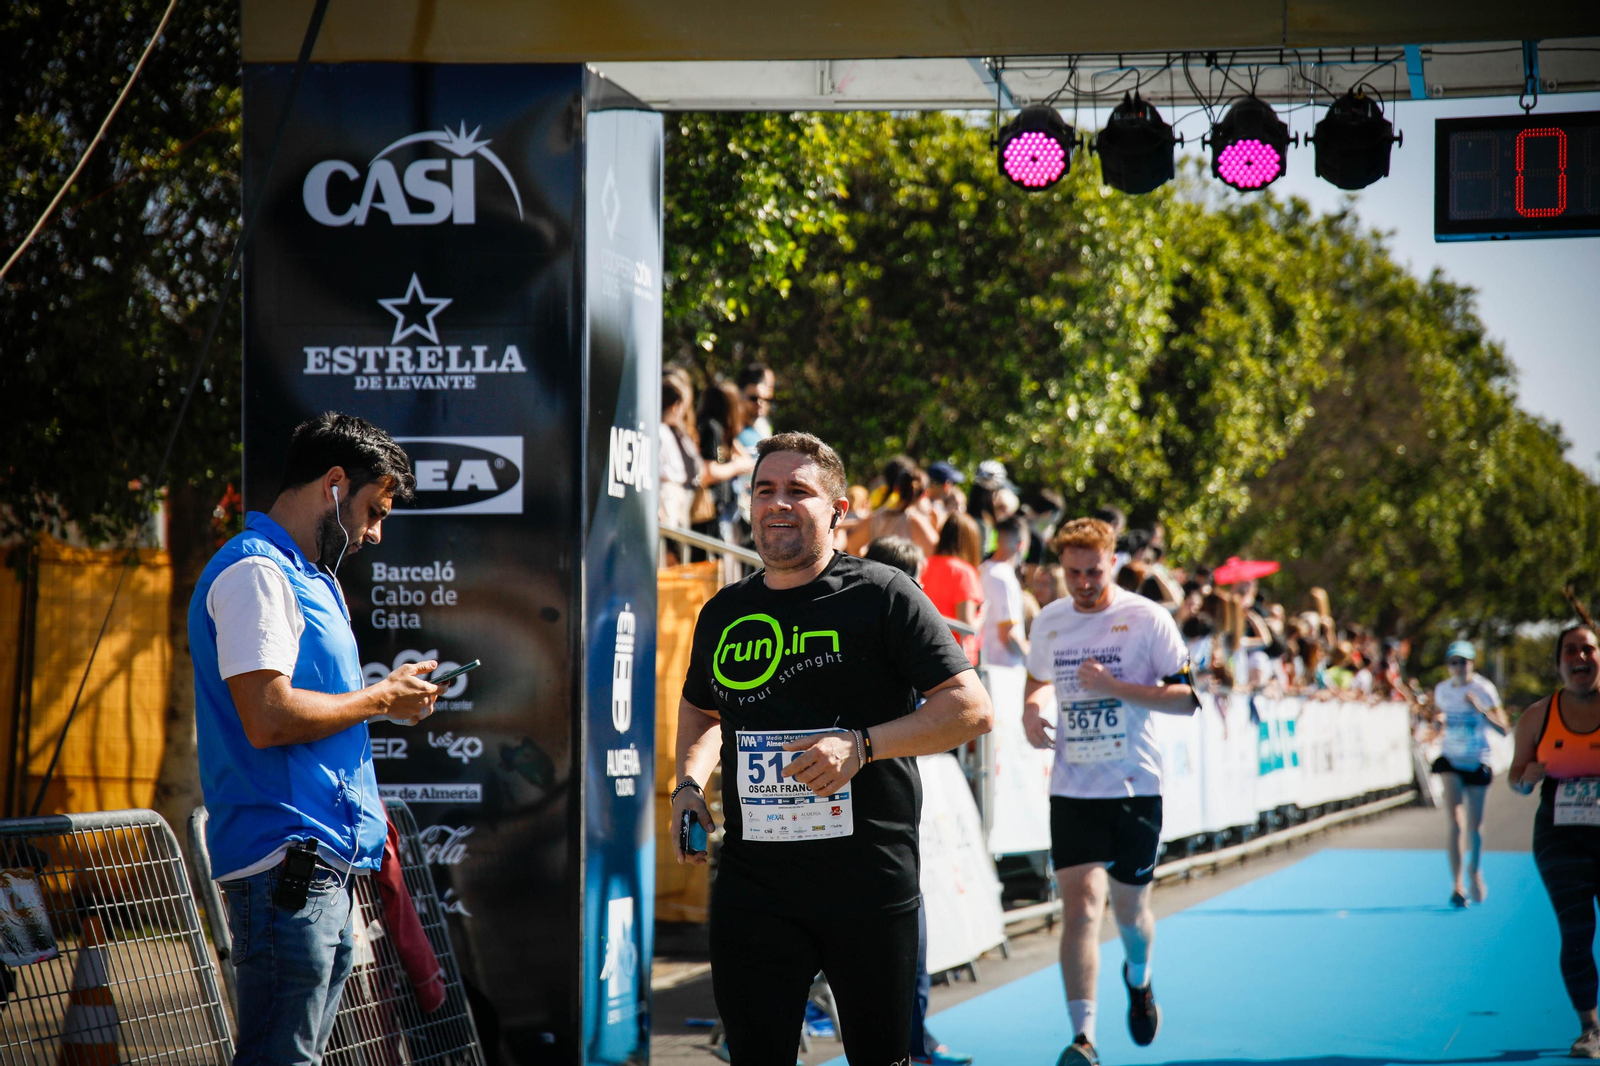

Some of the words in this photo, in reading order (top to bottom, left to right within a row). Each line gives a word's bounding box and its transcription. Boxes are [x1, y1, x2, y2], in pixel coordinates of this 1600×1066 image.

[1515, 127, 1567, 218] 0
[302, 158, 476, 227] CASI
[303, 345, 527, 375] ESTRELLA
[354, 375, 382, 390] DE
[385, 375, 477, 390] LEVANTE
[414, 459, 499, 492] EA
[371, 560, 455, 582] Barceló
[371, 585, 426, 606] Cabo
[430, 585, 458, 606] de
[371, 609, 421, 630] Gata
[778, 652, 843, 684] strenght
[1067, 708, 1118, 730] 5676
[399, 787, 417, 799] de
[419, 785, 478, 799] Almería
[748, 784, 777, 793] OSCAR
[780, 783, 812, 793] FRANC
